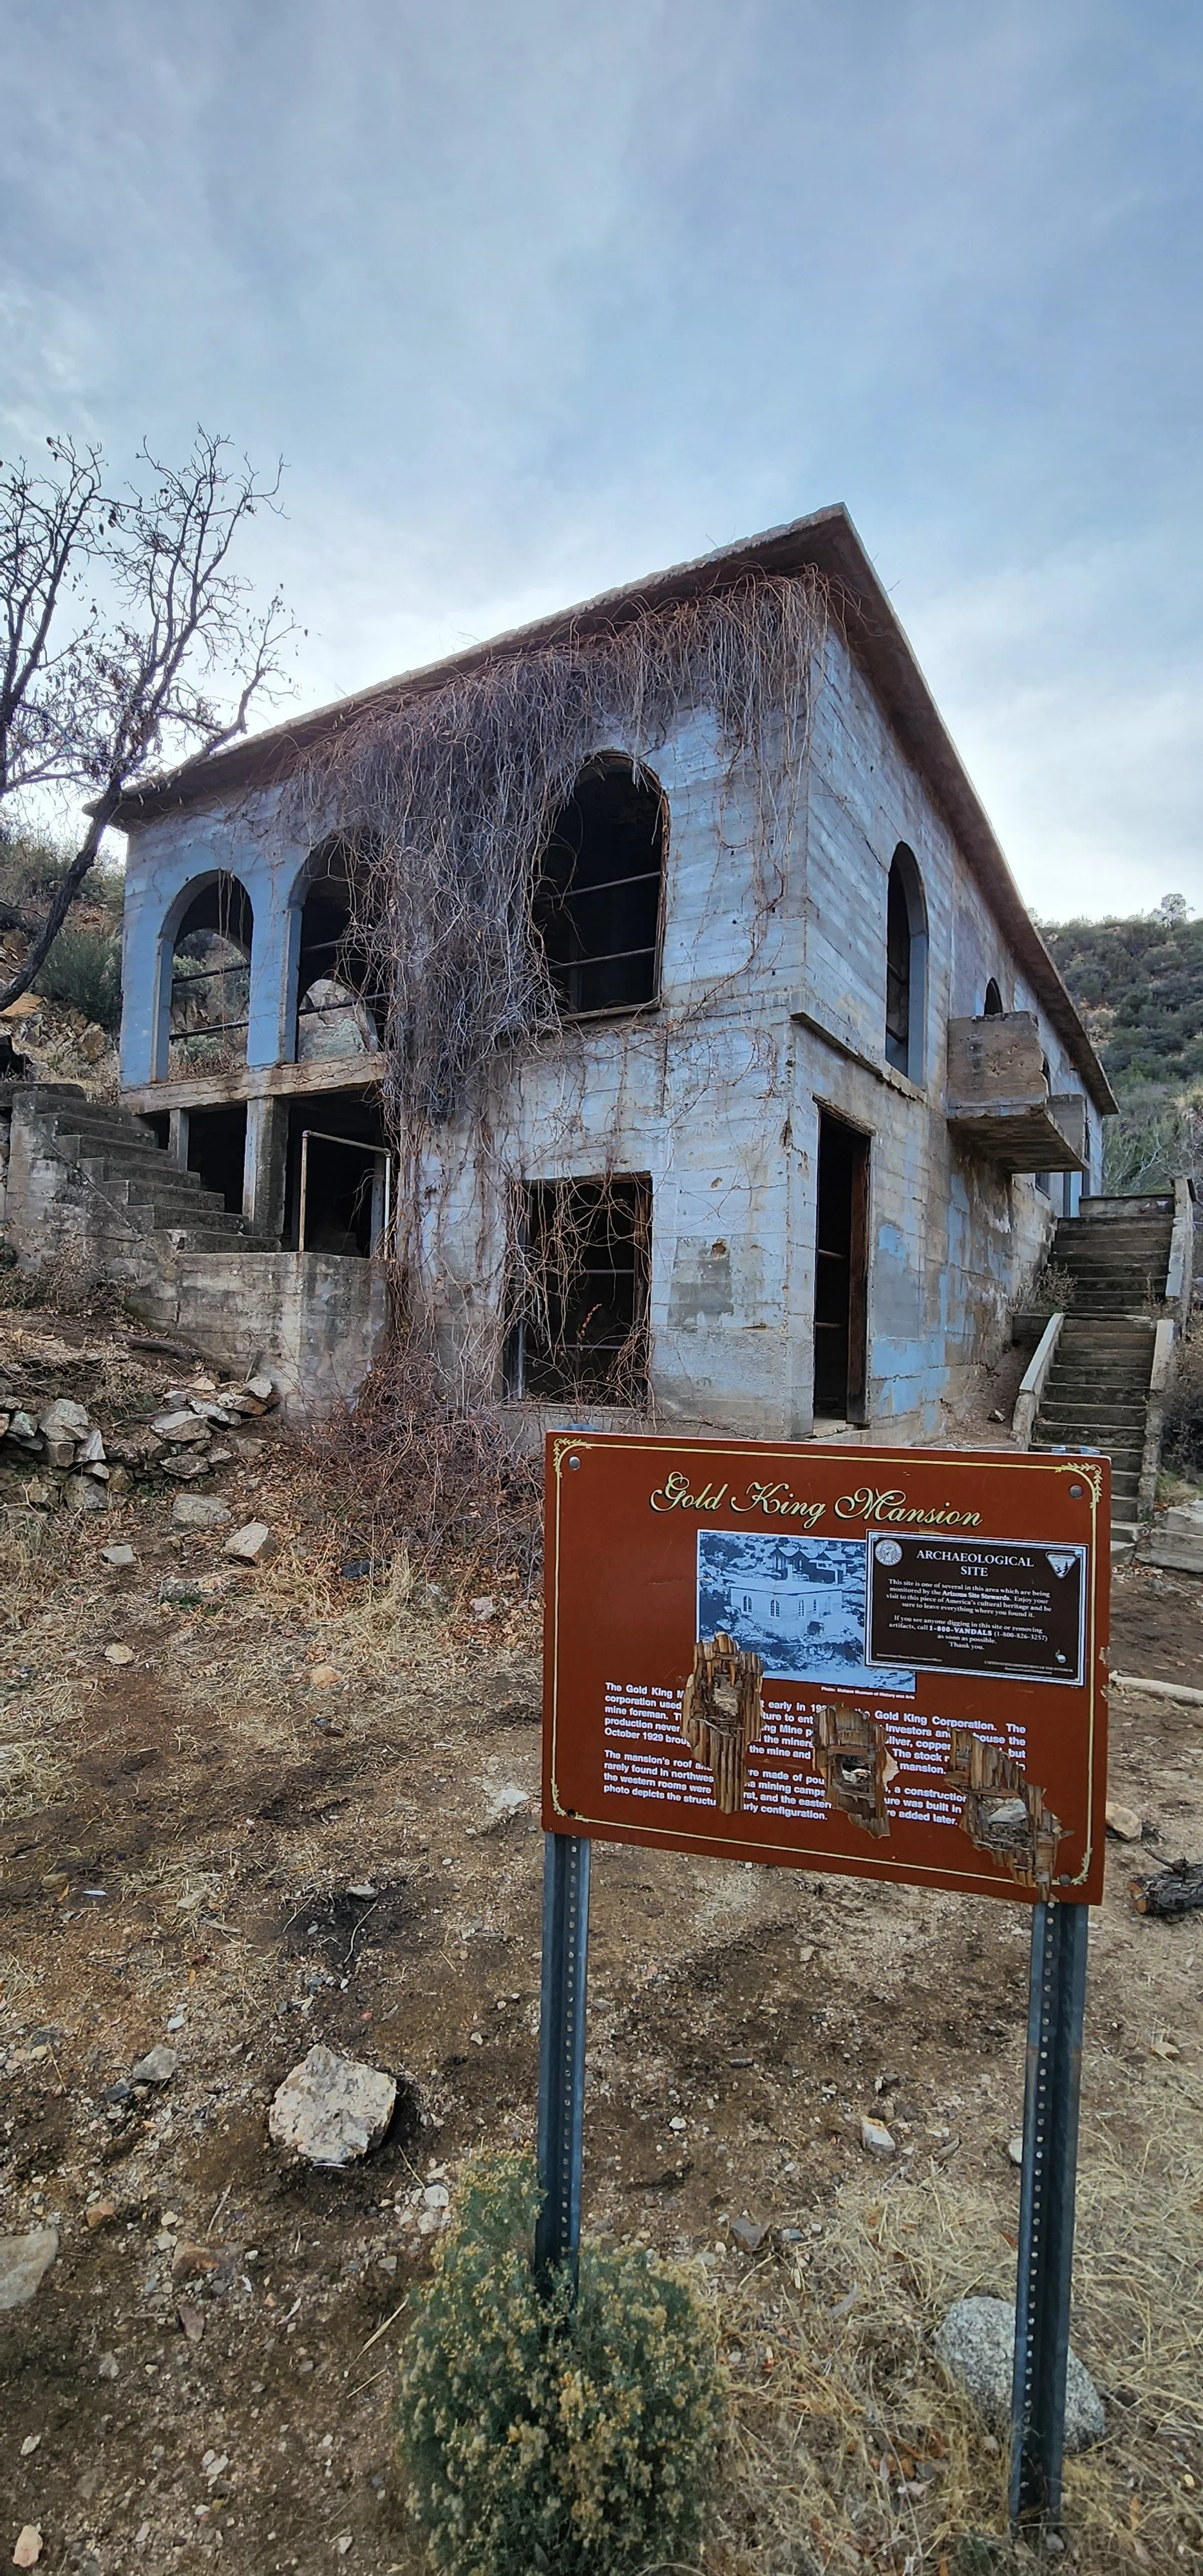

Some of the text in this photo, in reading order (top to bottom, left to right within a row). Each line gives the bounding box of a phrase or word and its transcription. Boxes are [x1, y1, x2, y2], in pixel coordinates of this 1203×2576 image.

[649, 1471, 983, 1530] Gold King Mansion
[916, 1549, 1035, 1567] ARCHAEOLOGICAL
[960, 1566, 989, 1577] SITE
[941, 1605, 973, 1614] everything
[945, 1597, 976, 1605] America's
[977, 1600, 1002, 1608] cultural
[1003, 1602, 1029, 1611] heritage
[1014, 1596, 1032, 1604] Enjoy
[1032, 1589, 1051, 1598] being
[929, 1625, 992, 1636] 1-800-VANDALS
[1012, 1625, 1043, 1634] removing
[605, 1682, 621, 1692] The
[626, 1684, 647, 1694] Gold
[652, 1687, 672, 1699] King
[768, 1701, 792, 1712] early
[797, 1703, 805, 1711] in
[875, 1710, 899, 1721] Gold
[904, 1713, 927, 1725] King
[932, 1716, 997, 1732] Corporation.
[1006, 1723, 1026, 1734] The
[605, 1695, 656, 1707] corporation
[659, 1701, 681, 1710] used
[784, 1714, 794, 1722] to
[885, 1723, 932, 1737] investors
[1009, 1736, 1026, 1746] the
[605, 1706, 627, 1715] mine
[629, 1708, 668, 1719] foreman.
[761, 1724, 777, 1734] ng
[779, 1725, 802, 1735] Mine
[885, 1736, 913, 1748] ilver,
[916, 1740, 951, 1751] copper
[1008, 1748, 1026, 1759] but
[605, 1717, 653, 1729] production
[655, 1723, 680, 1732] never
[764, 1735, 779, 1743] the
[782, 1737, 814, 1748] miners
[892, 1748, 912, 1759] The
[914, 1752, 942, 1762] stock
[605, 1728, 947, 1775] October 1929 broug the mine and mansion.
[604, 1750, 621, 1759] The
[624, 1753, 670, 1765] mansion's
[674, 1759, 692, 1768] roof
[763, 1770, 789, 1781] made
[806, 1776, 825, 1785] pou
[895, 1786, 901, 1794] a
[604, 1762, 629, 1774] rarely
[631, 1765, 658, 1776] found
[660, 1768, 668, 1776] in
[671, 1770, 715, 1783] northwes
[758, 1782, 791, 1794] mining
[903, 1799, 924, 1809] was
[926, 1801, 949, 1813] built
[952, 1804, 962, 1814] in
[604, 1773, 618, 1781] the
[620, 1776, 656, 1786] western
[658, 1780, 687, 1791] rooms
[689, 1785, 712, 1794] were
[743, 1792, 758, 1801] rst,
[760, 1794, 778, 1803] and
[781, 1795, 796, 1805] the
[799, 1799, 832, 1809] eastern
[899, 1810, 930, 1821] added
[933, 1814, 958, 1826] later.
[604, 1784, 630, 1795] photo
[632, 1788, 665, 1799] depicts
[667, 1793, 681, 1801] the
[684, 1795, 716, 1806] structu
[761, 1805, 828, 1820] configuration.
